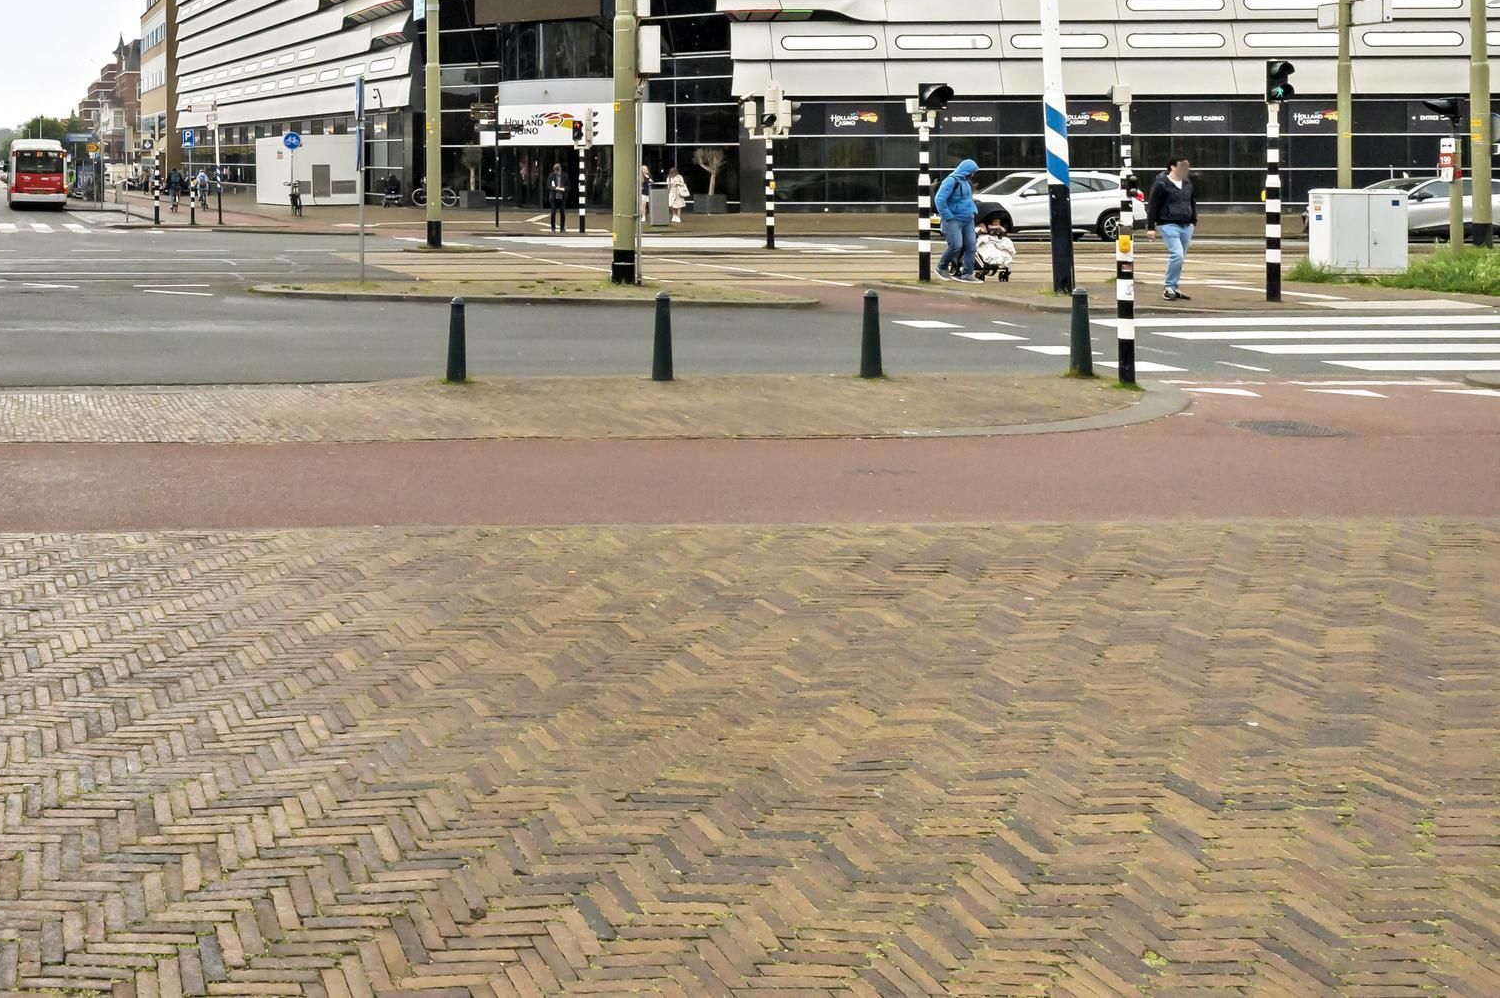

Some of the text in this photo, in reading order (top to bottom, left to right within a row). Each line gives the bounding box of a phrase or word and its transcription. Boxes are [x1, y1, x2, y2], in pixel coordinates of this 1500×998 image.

[830, 114, 859, 122] HOLLAND
[1296, 118, 1320, 126] CASINO
[834, 120, 856, 128] CASINO
